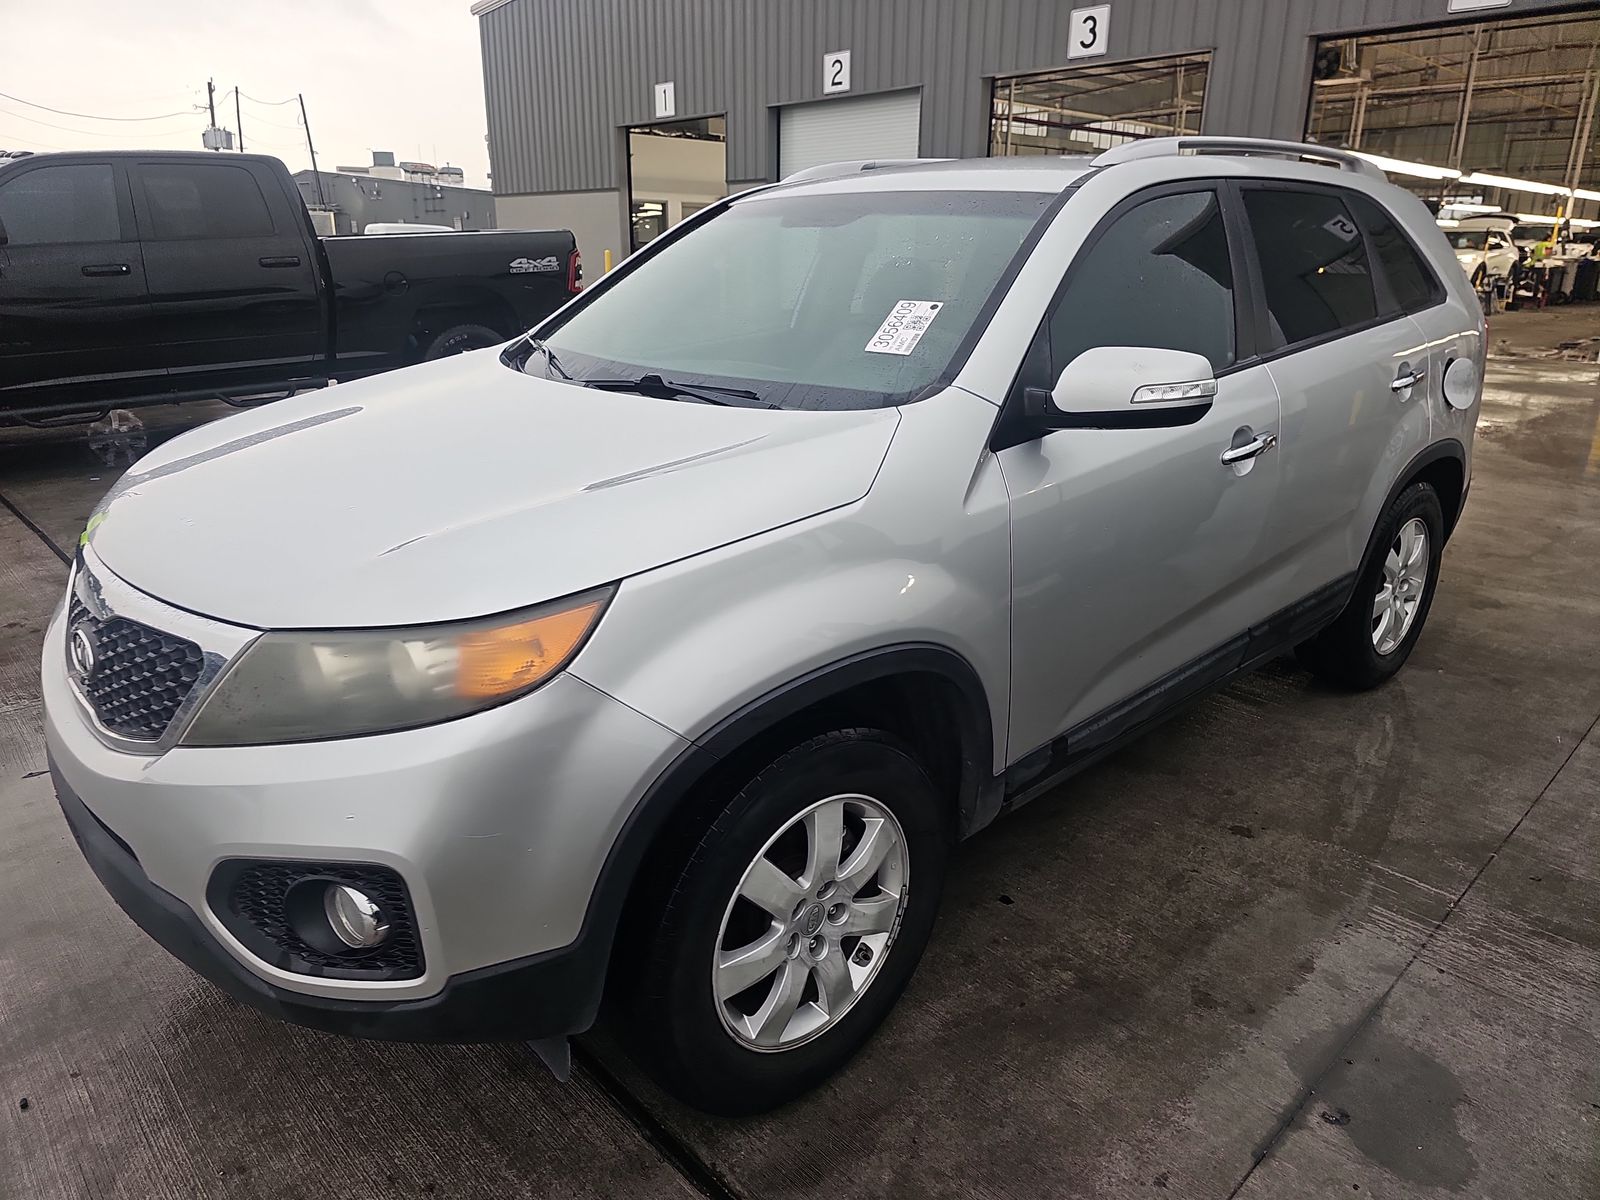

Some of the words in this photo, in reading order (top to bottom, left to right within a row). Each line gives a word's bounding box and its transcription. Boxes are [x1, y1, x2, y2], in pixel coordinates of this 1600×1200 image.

[1080, 15, 1097, 49] 3
[831, 59, 843, 86] 2
[873, 302, 917, 348] 3056409
